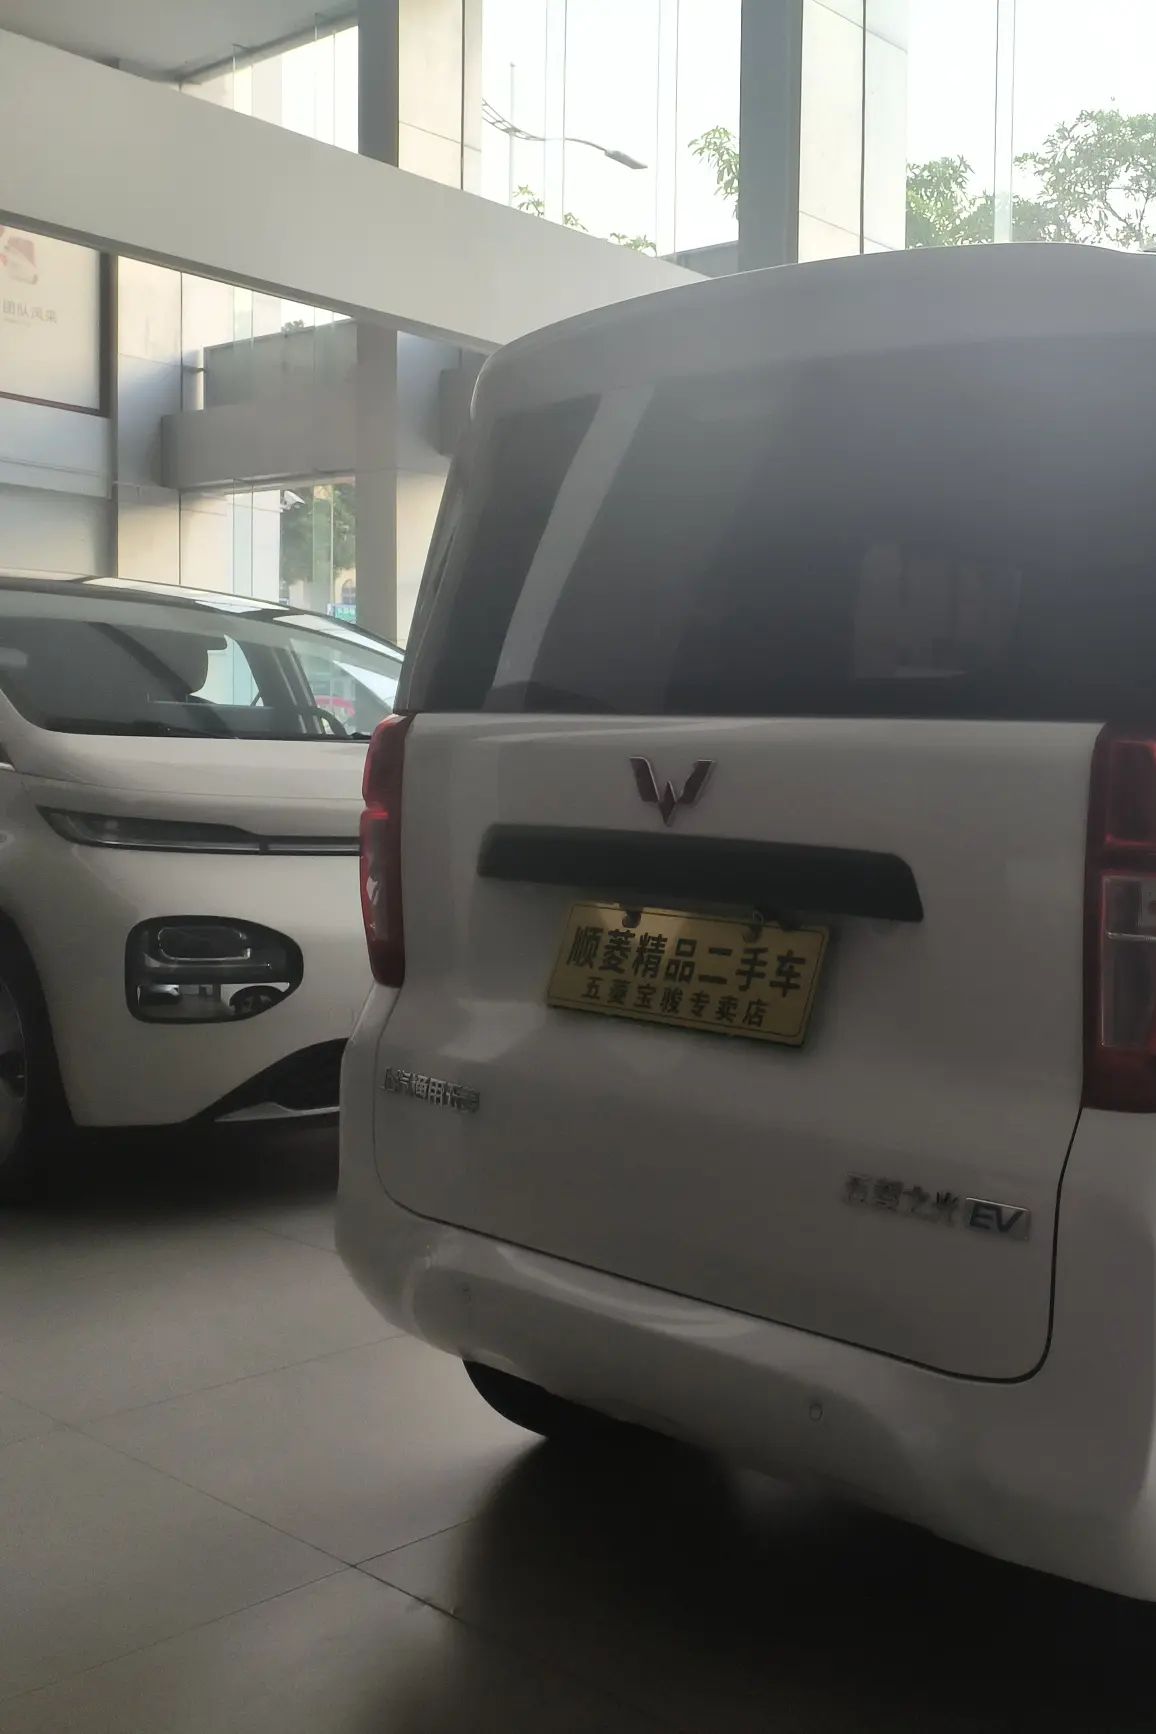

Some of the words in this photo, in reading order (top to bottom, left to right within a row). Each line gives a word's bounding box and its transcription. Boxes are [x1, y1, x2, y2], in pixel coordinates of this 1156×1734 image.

[566, 924, 807, 998] 顺菱精品二手车
[581, 975, 771, 1028] 五菱宝骏专卖店
[968, 1200, 1026, 1235] EV
